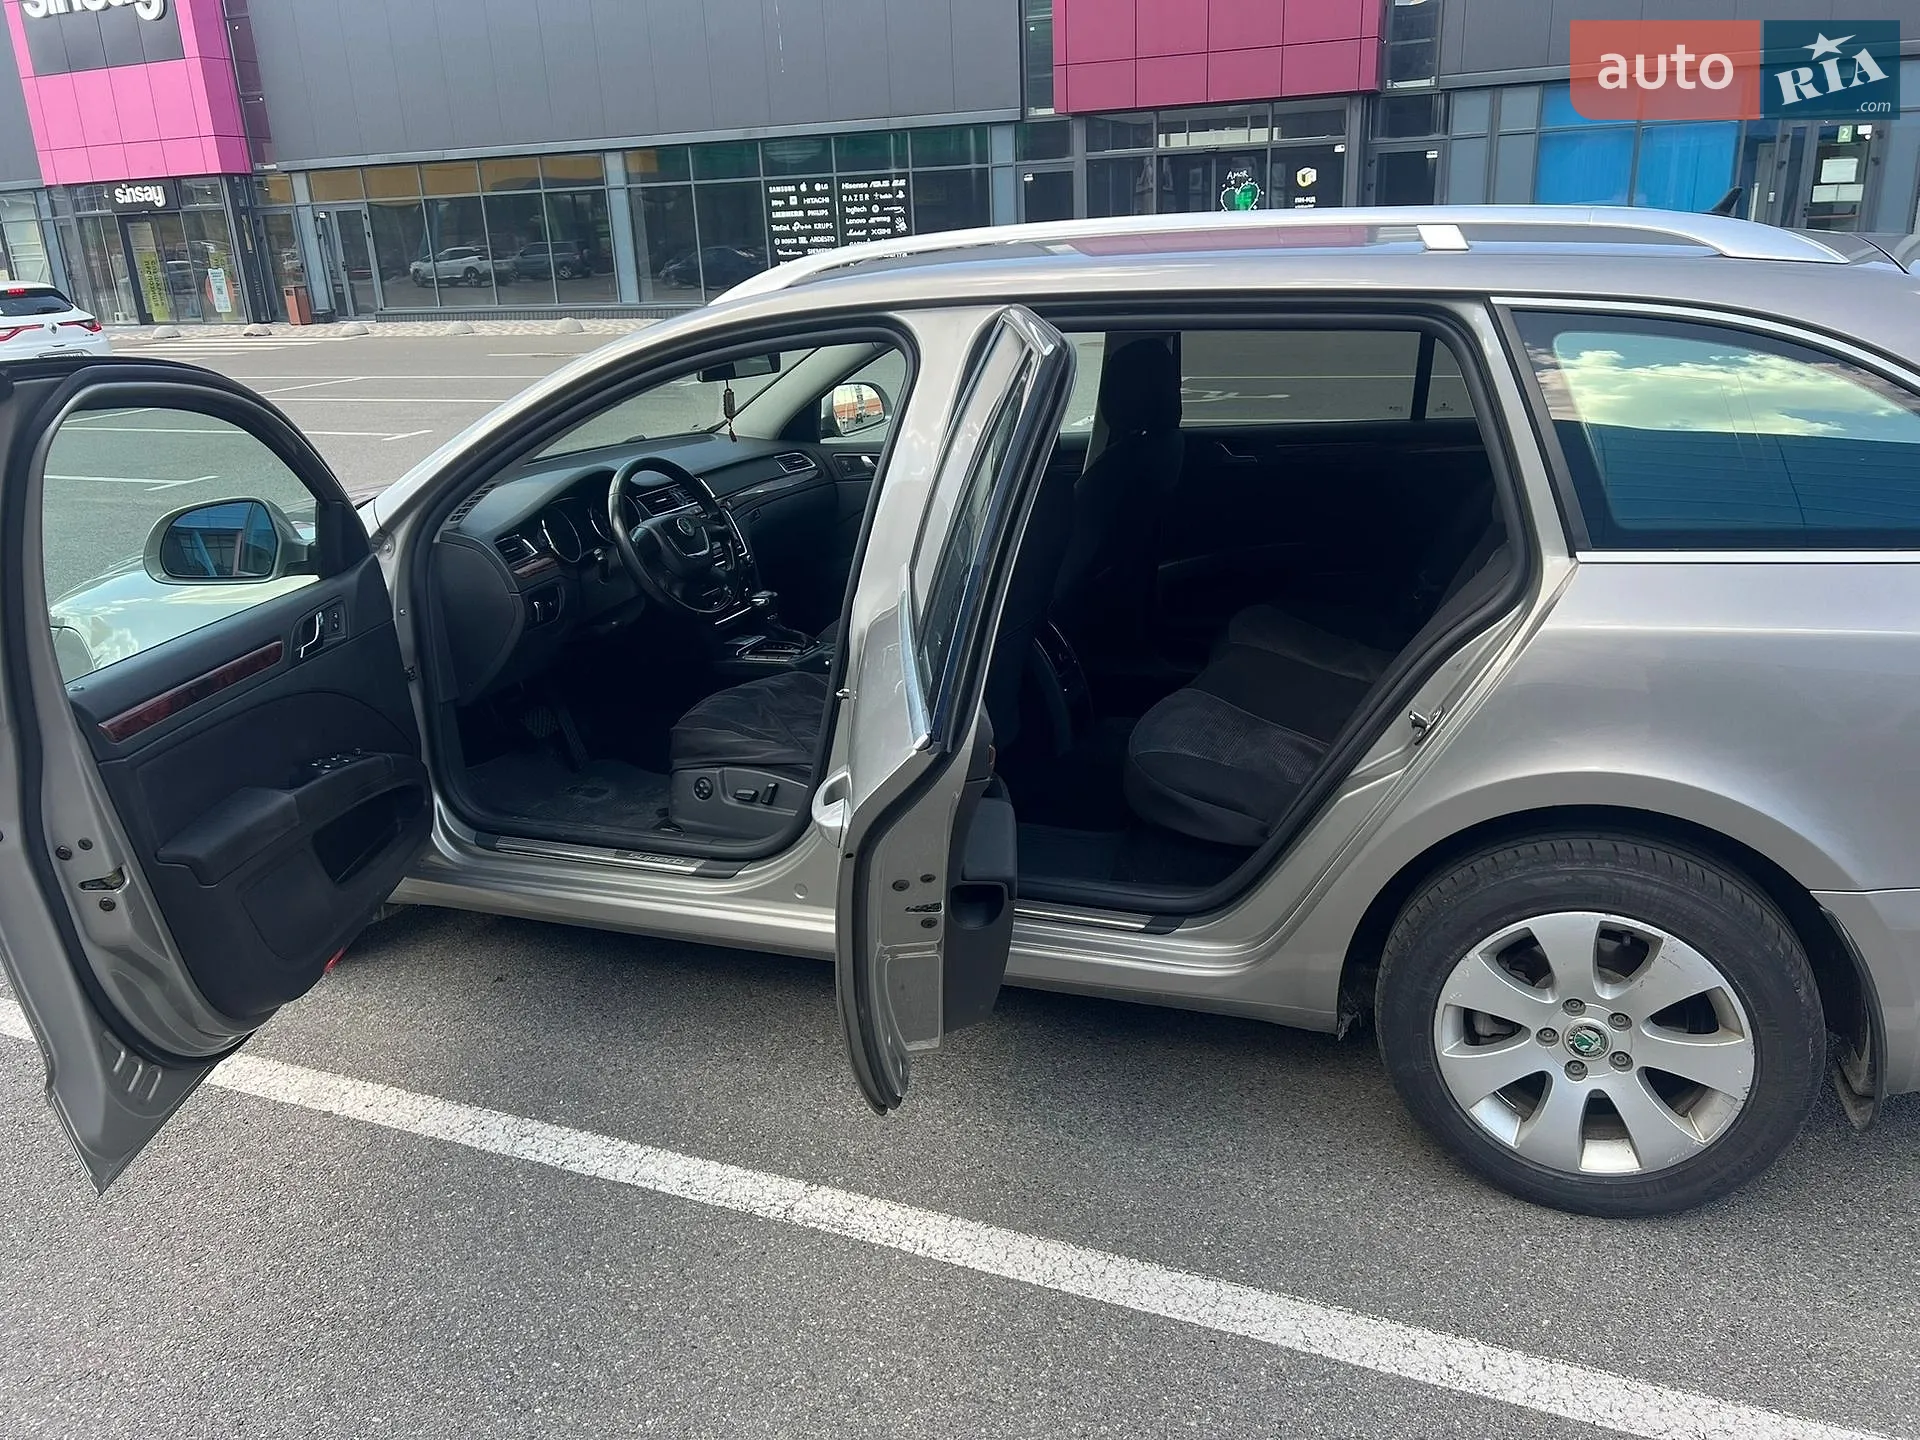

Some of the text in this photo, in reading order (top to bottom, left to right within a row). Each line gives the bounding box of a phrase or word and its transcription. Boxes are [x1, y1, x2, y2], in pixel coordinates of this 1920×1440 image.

[114, 183, 166, 208] sinsay
[842, 193, 870, 202] RAZER
[813, 222, 834, 230] KRUPS
